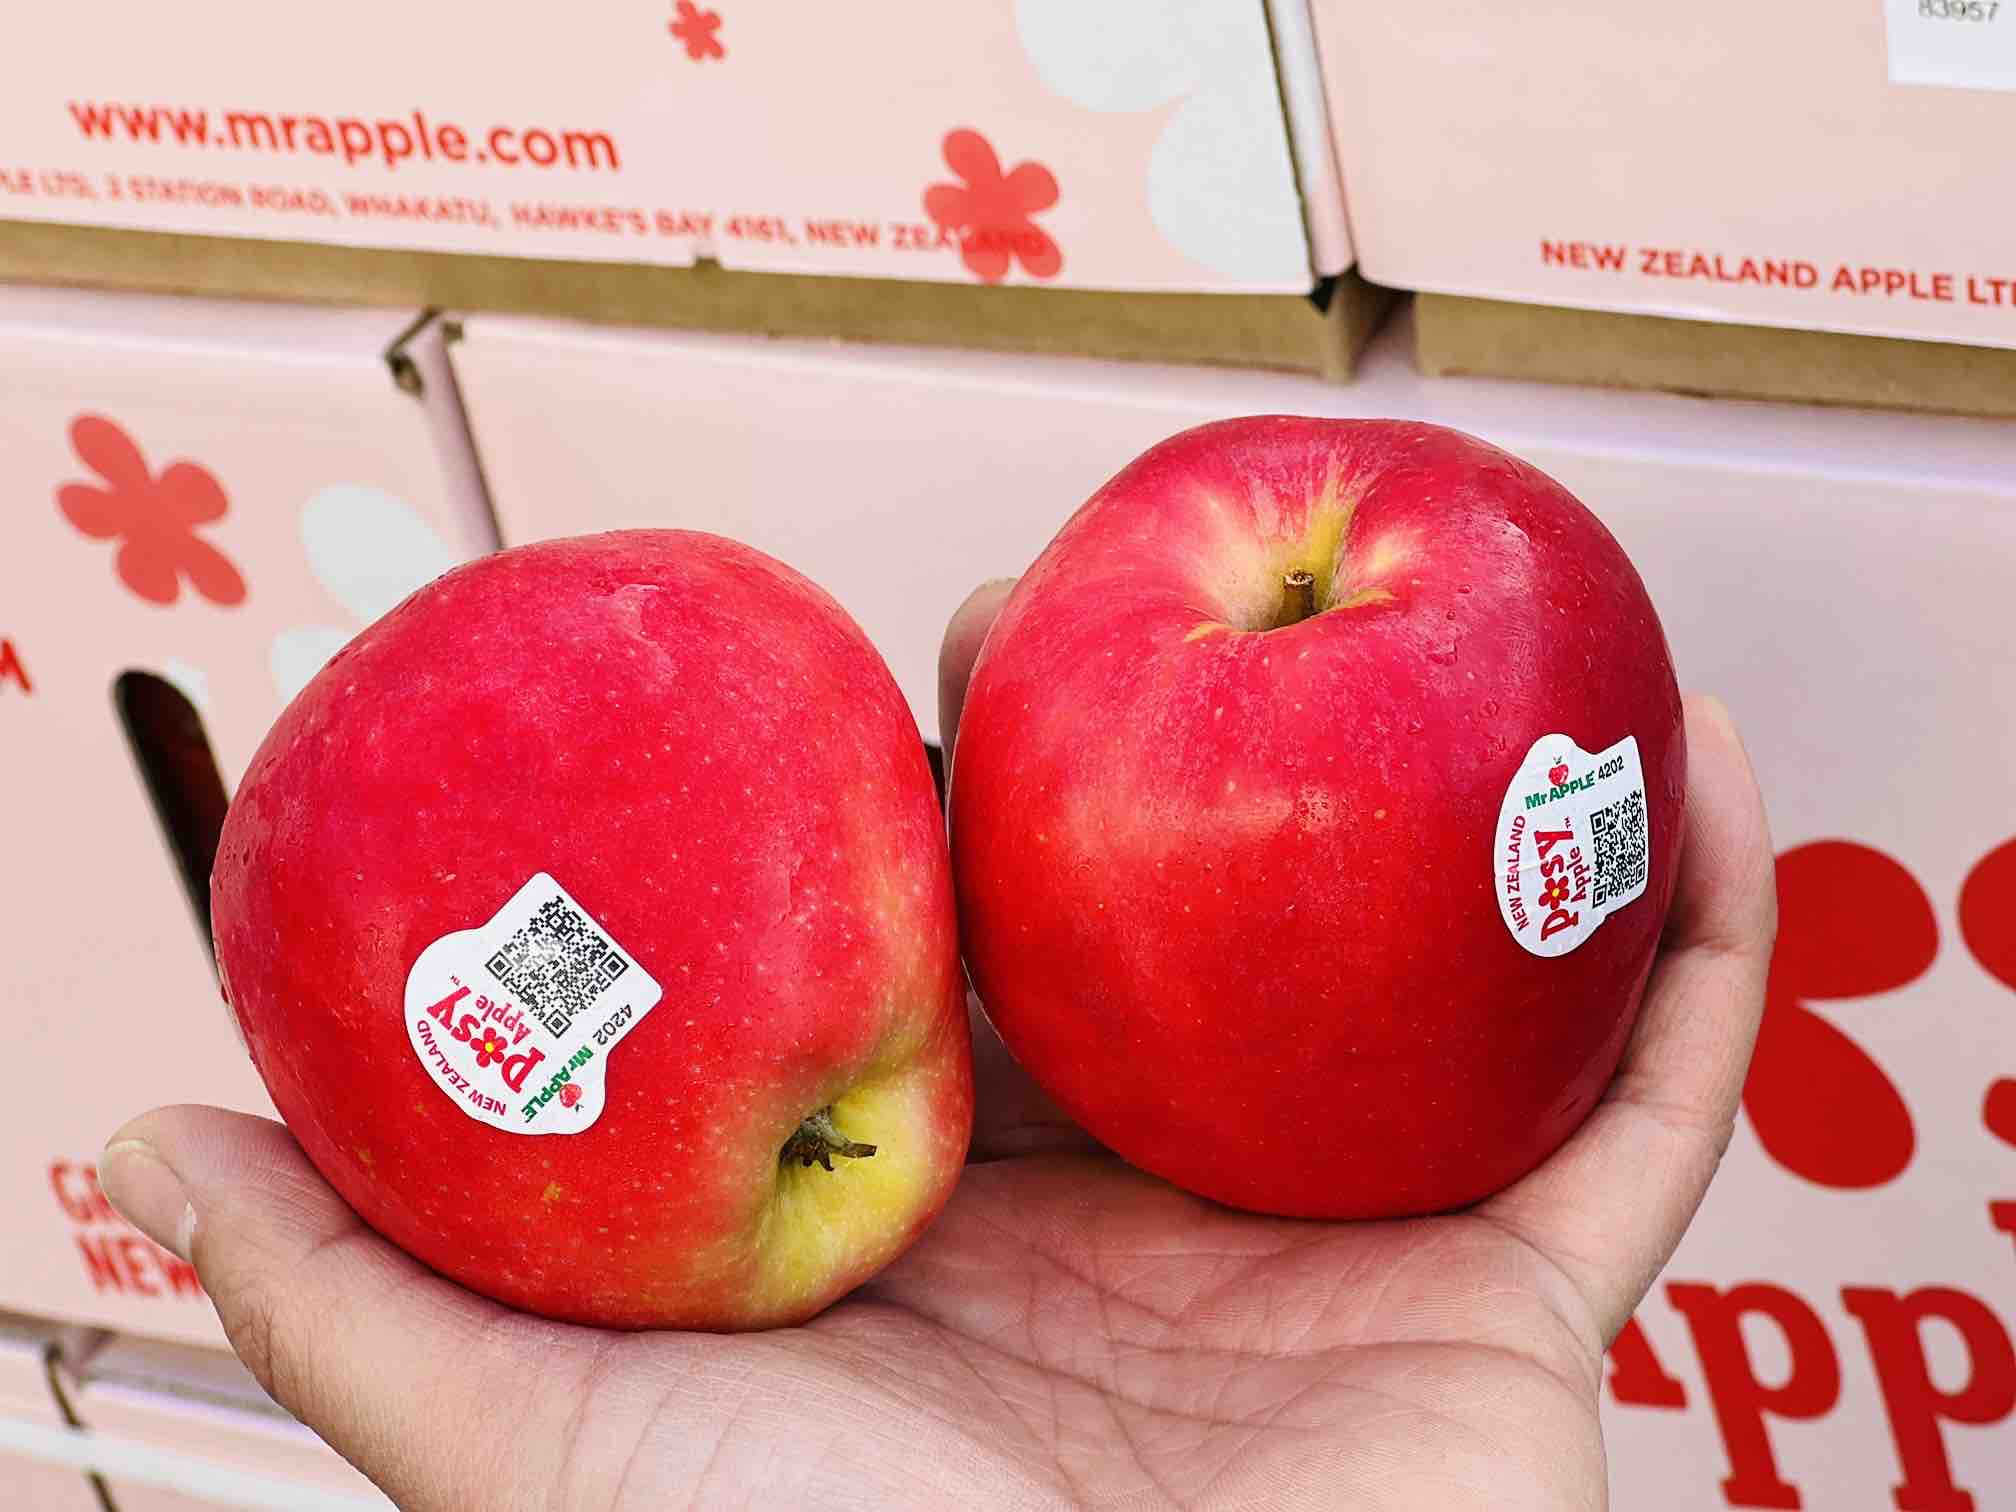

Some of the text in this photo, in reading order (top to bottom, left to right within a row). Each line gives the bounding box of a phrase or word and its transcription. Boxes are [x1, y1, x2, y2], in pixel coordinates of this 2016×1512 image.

[67, 99, 620, 171] www.mrapple.com
[654, 208, 713, 238] BAY
[805, 221, 880, 249] NEW
[1540, 238, 1626, 272] NEW
[1639, 249, 1819, 289] ZEALAND
[1832, 266, 1954, 301] APPLE
[1598, 755, 1626, 781] 4202
[1505, 814, 1530, 932] NEW ZEALAND
[1566, 846, 1593, 904] Apple
[474, 994, 534, 1046] Apple
[591, 1003, 634, 1046] 4202
[416, 1018, 508, 1117] NEW ZEALAND
